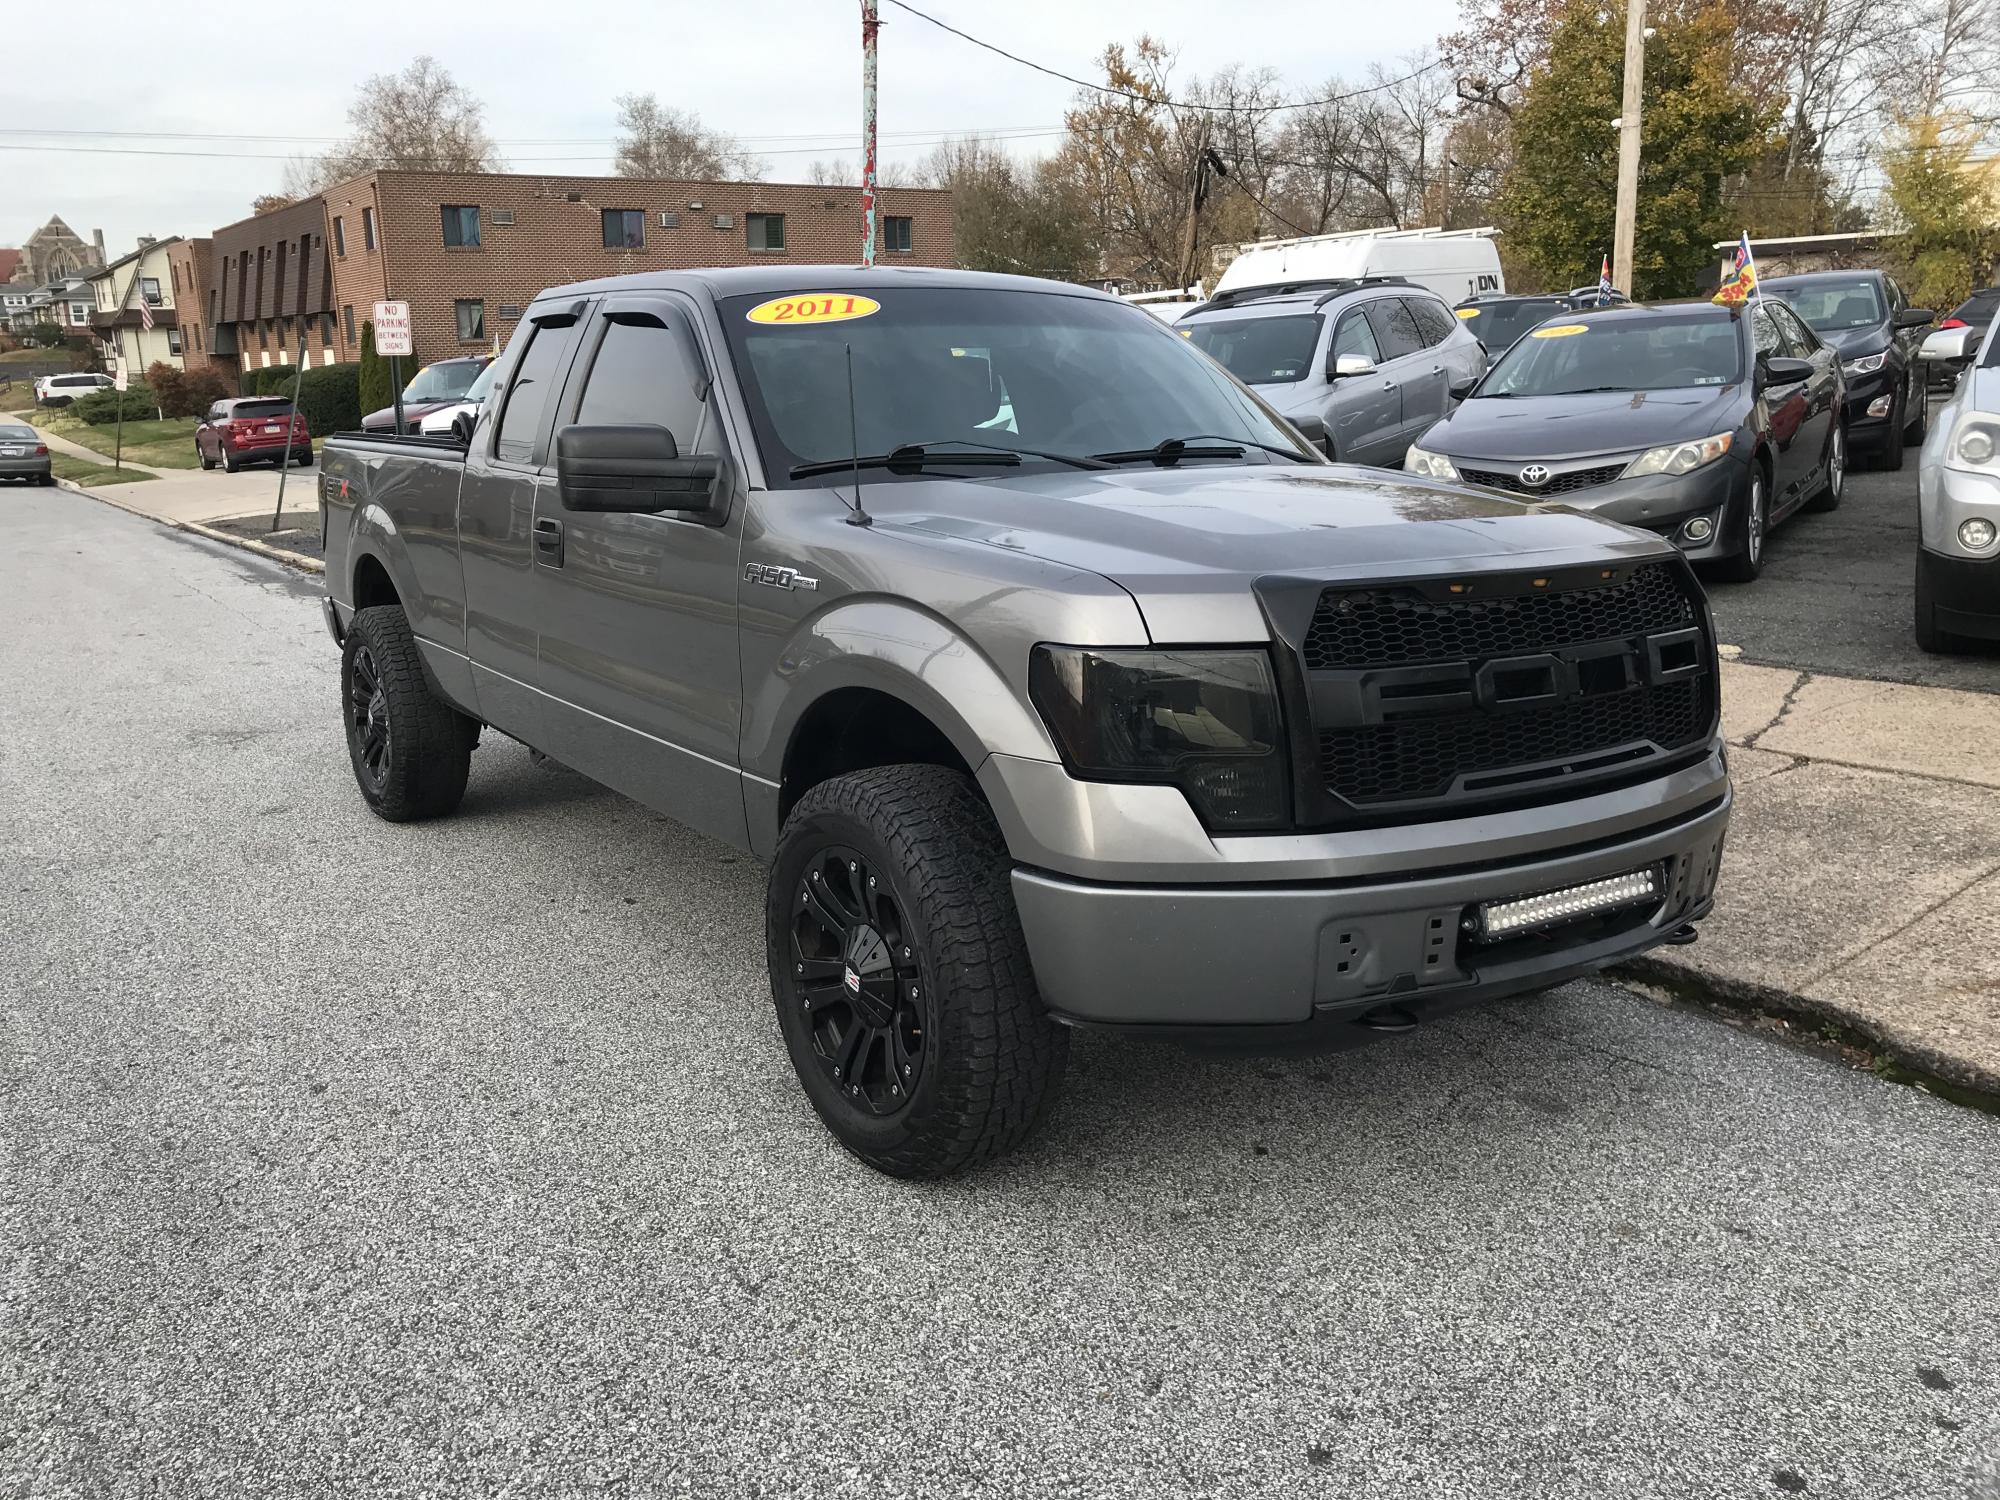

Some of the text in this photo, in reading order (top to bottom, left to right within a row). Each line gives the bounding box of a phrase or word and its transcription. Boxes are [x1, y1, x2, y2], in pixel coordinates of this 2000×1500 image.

[384, 305, 398, 316] NO
[773, 298, 857, 321] 2011
[377, 318, 408, 329] PARKING
[378, 331, 408, 340] BETWEEN
[384, 342, 404, 350] SIGNS
